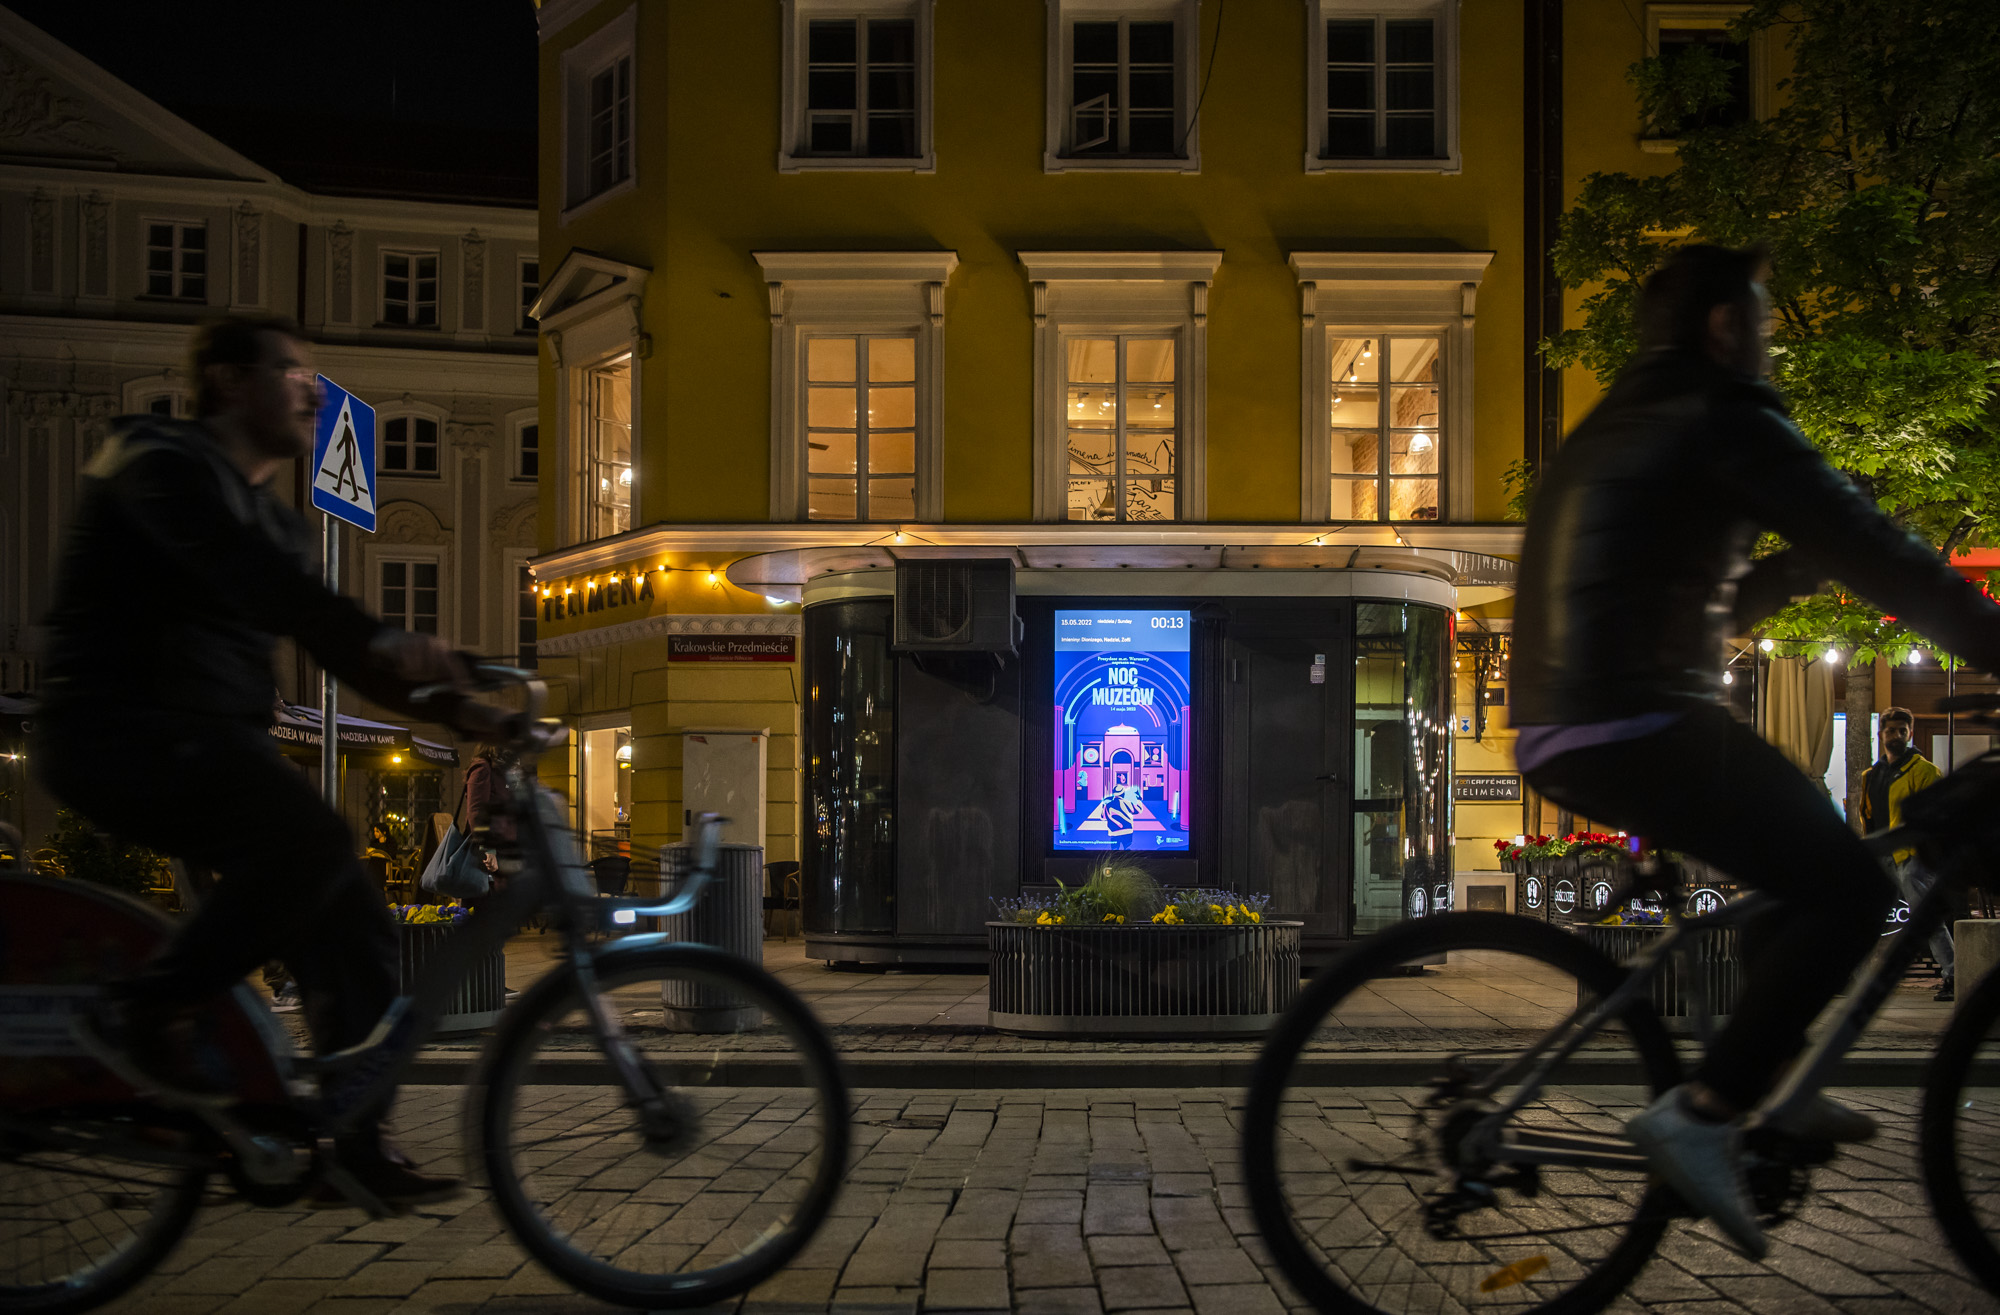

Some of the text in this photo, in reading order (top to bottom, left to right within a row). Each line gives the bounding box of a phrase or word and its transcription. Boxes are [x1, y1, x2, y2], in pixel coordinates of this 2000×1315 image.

[542, 572, 655, 622] TELIMENA
[1151, 617, 1184, 628] 00:13
[674, 641, 789, 653] Krakowskie Przedmieście
[1108, 667, 1138, 685] NOC
[1092, 684, 1154, 706] MUZEÓW
[268, 725, 298, 741] NADZIEJA
[298, 730, 305, 741] W
[341, 732, 369, 743] NADZIEJA
[369, 734, 376, 742] W
[377, 736, 395, 744] KAWIE
[1457, 788, 1512, 796] TELIMENA
